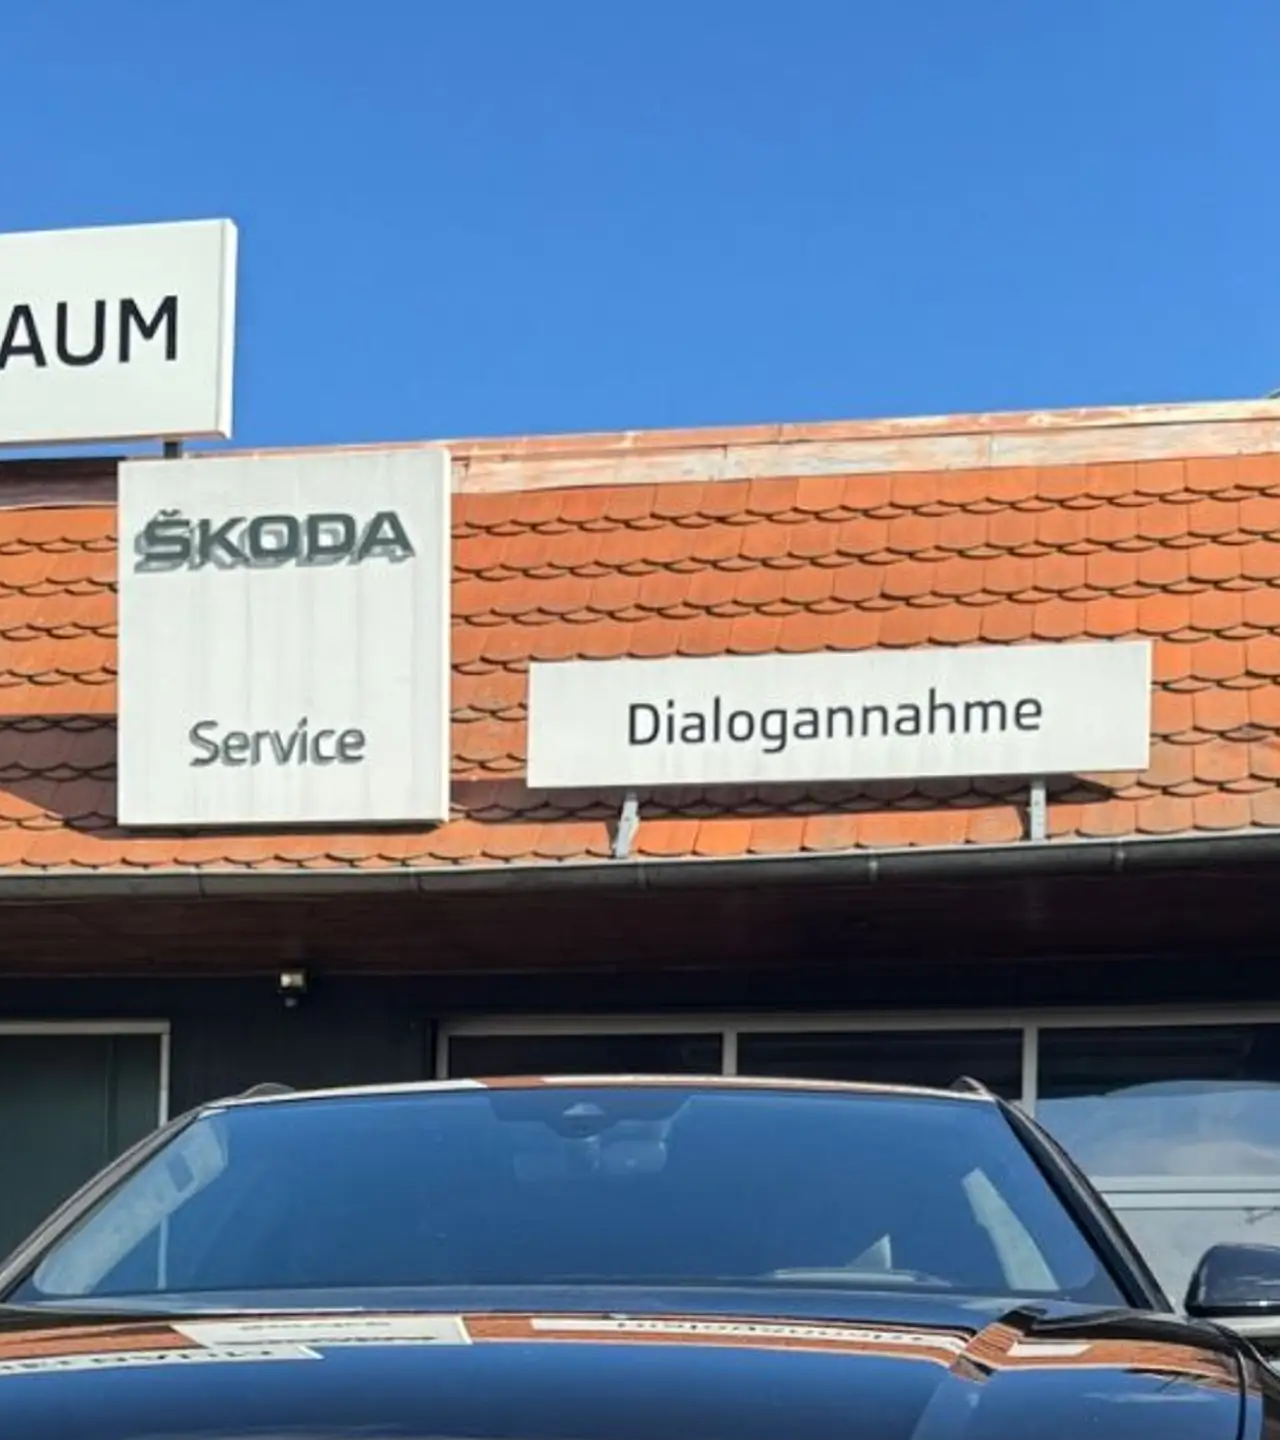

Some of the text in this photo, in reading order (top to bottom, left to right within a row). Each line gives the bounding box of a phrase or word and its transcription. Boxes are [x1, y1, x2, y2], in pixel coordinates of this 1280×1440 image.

[141, 508, 416, 565] ŠKODA
[189, 715, 366, 766] Service
[628, 687, 1043, 753] Dialogannahme
